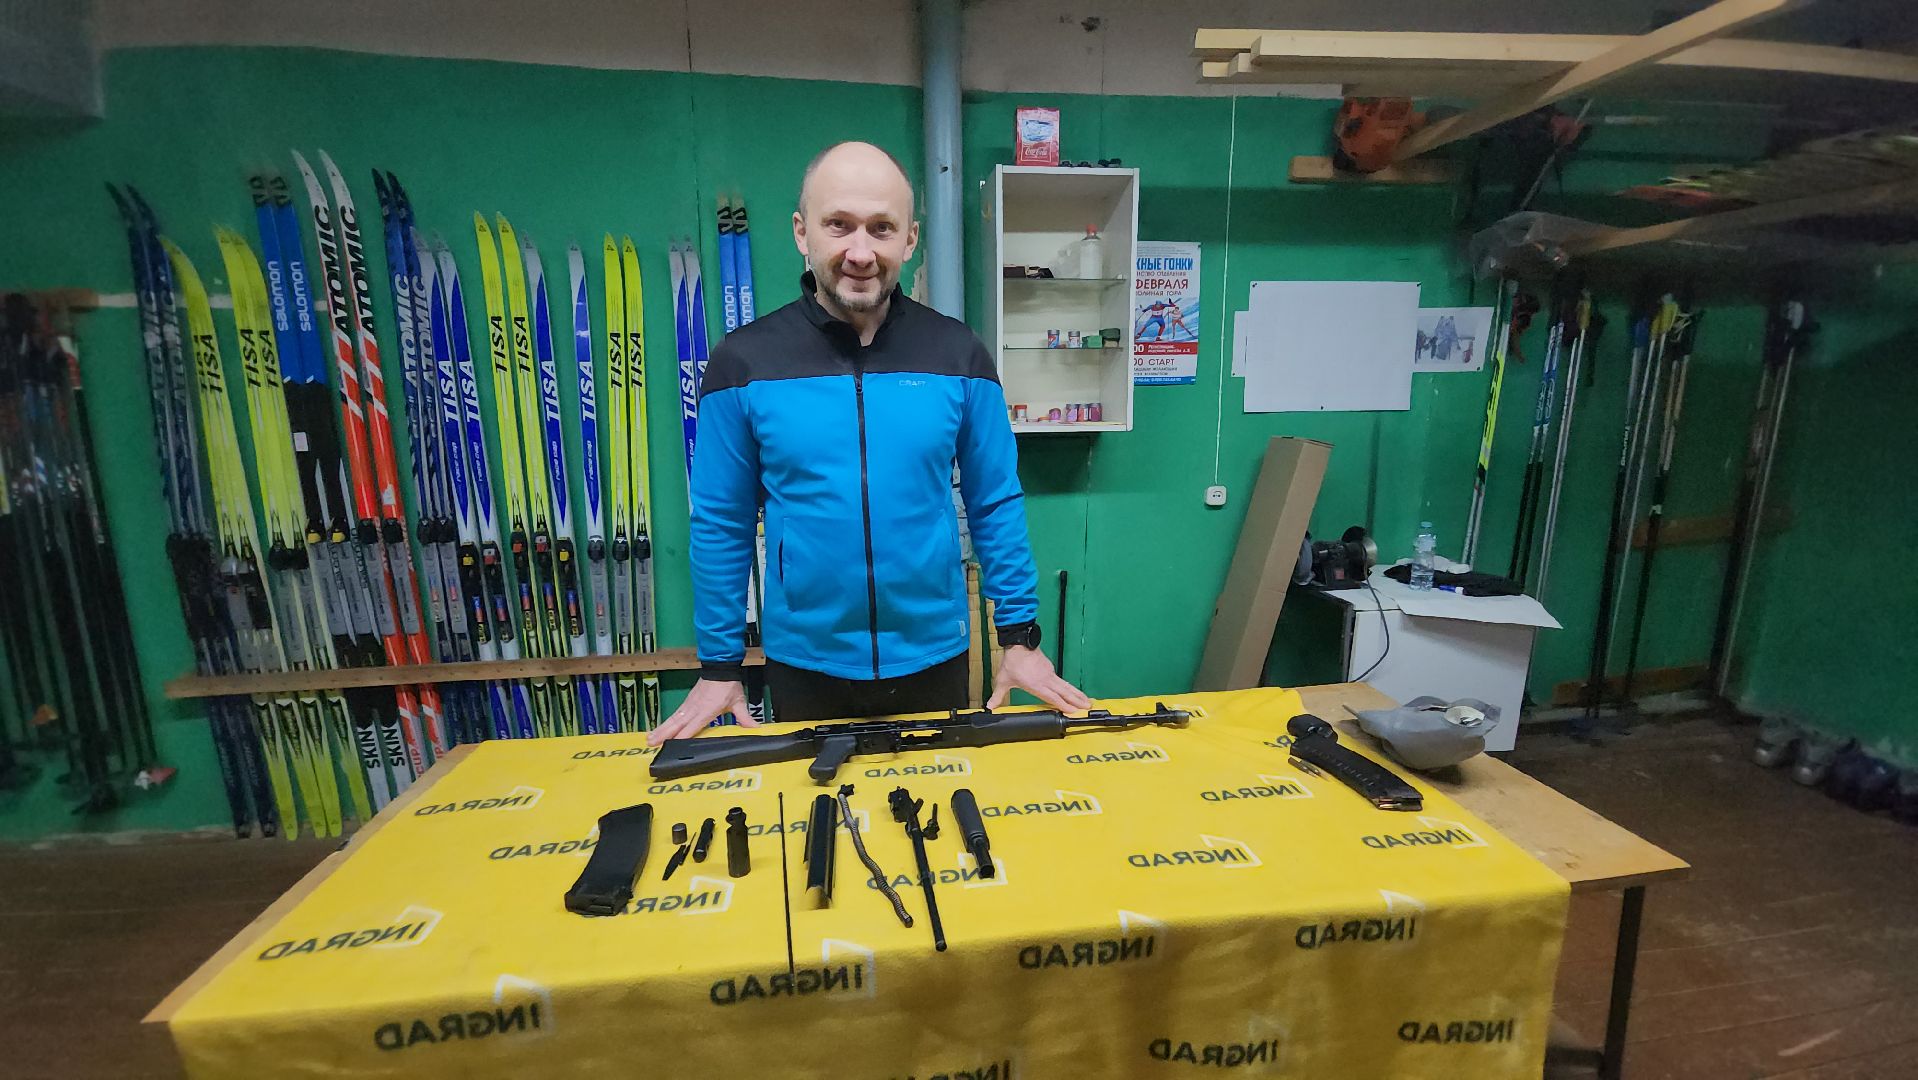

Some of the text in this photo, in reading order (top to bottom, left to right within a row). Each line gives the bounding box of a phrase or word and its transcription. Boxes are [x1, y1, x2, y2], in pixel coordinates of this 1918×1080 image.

[315, 205, 350, 333] ATOMIC
[340, 206, 376, 333] ATOMIC
[1136, 278, 1189, 290] ФЕВРАЛЯ
[1164, 257, 1193, 270] ГОНКИ
[267, 261, 289, 332] salomon
[290, 261, 312, 332] salomon
[240, 328, 262, 388] TISA
[258, 329, 280, 388] TISA
[394, 274, 419, 388] ATOMIC
[411, 275, 435, 389] ATOMIC
[490, 316, 508, 374] TISA
[514, 316, 531, 374] TISA
[609, 332, 623, 389] TISA
[630, 332, 645, 389] TISA
[199, 334, 223, 393] TISA
[437, 360, 459, 423] TISA
[459, 360, 480, 423] TISA
[541, 360, 561, 423] TISA
[578, 360, 596, 422] TISA
[681, 360, 698, 422] TISA
[1148, 358, 1175, 366] СТАРТ
[358, 727, 381, 769] SKIN
[382, 725, 405, 766] SKIN
